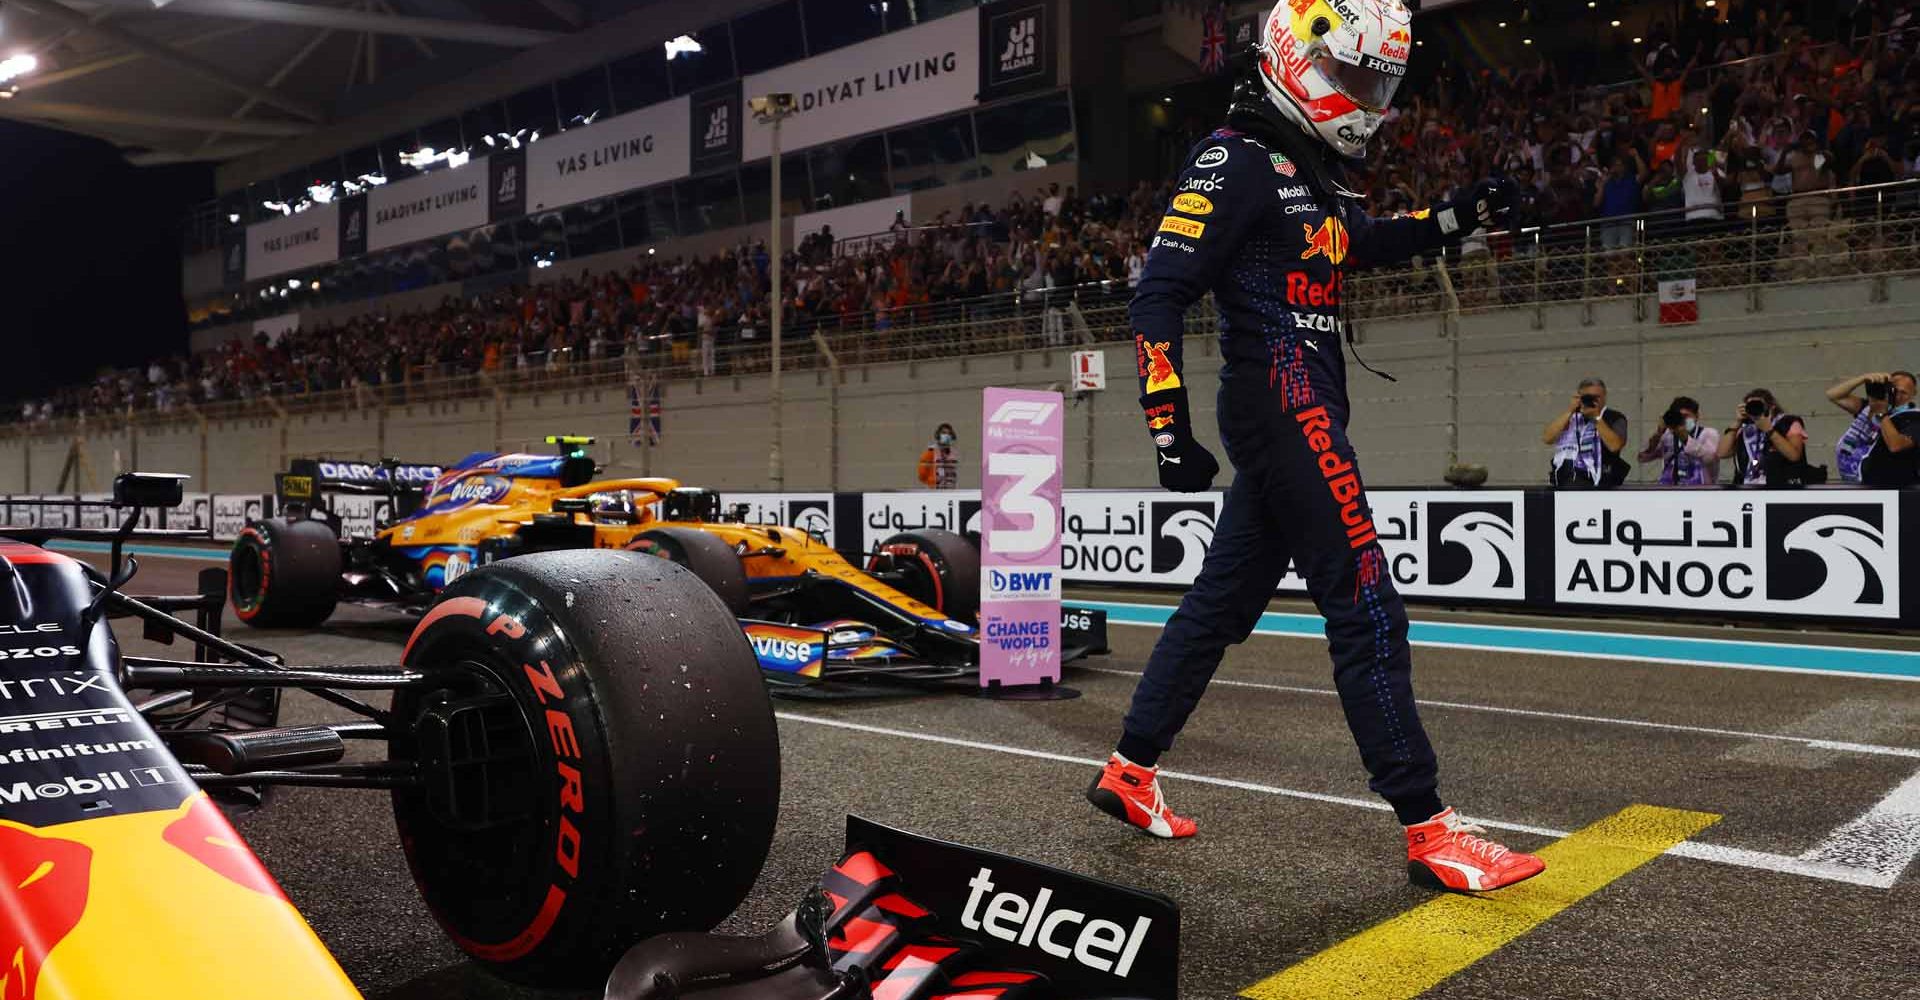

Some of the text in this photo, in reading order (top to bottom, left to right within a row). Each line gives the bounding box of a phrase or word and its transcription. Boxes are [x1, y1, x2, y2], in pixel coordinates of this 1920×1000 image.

[1270, 10, 1313, 78] edBull
[1380, 42, 1409, 61] RedBu
[874, 51, 957, 92] LIVING
[1366, 57, 1407, 76] HOND
[556, 135, 654, 176] YAS LIVING
[376, 200, 432, 226] SAADIYAT
[435, 185, 479, 210] LIVING
[1161, 238, 1195, 253] Cash App
[1295, 405, 1377, 549] RedBull
[988, 452, 1057, 553] 3
[1565, 503, 1753, 557] أدنوك
[1061, 545, 1145, 574] DNOC
[1009, 573, 1052, 591] BWT
[1566, 558, 1754, 600] ADNOC
[986, 621, 1049, 637] CHANGE
[1000, 636, 1049, 650] WORLD
[0, 670, 111, 700] trix
[0, 711, 134, 735] RELLI
[486, 613, 585, 878] P ZERO
[0, 771, 130, 804] Mobil
[960, 866, 1153, 977] telcel
